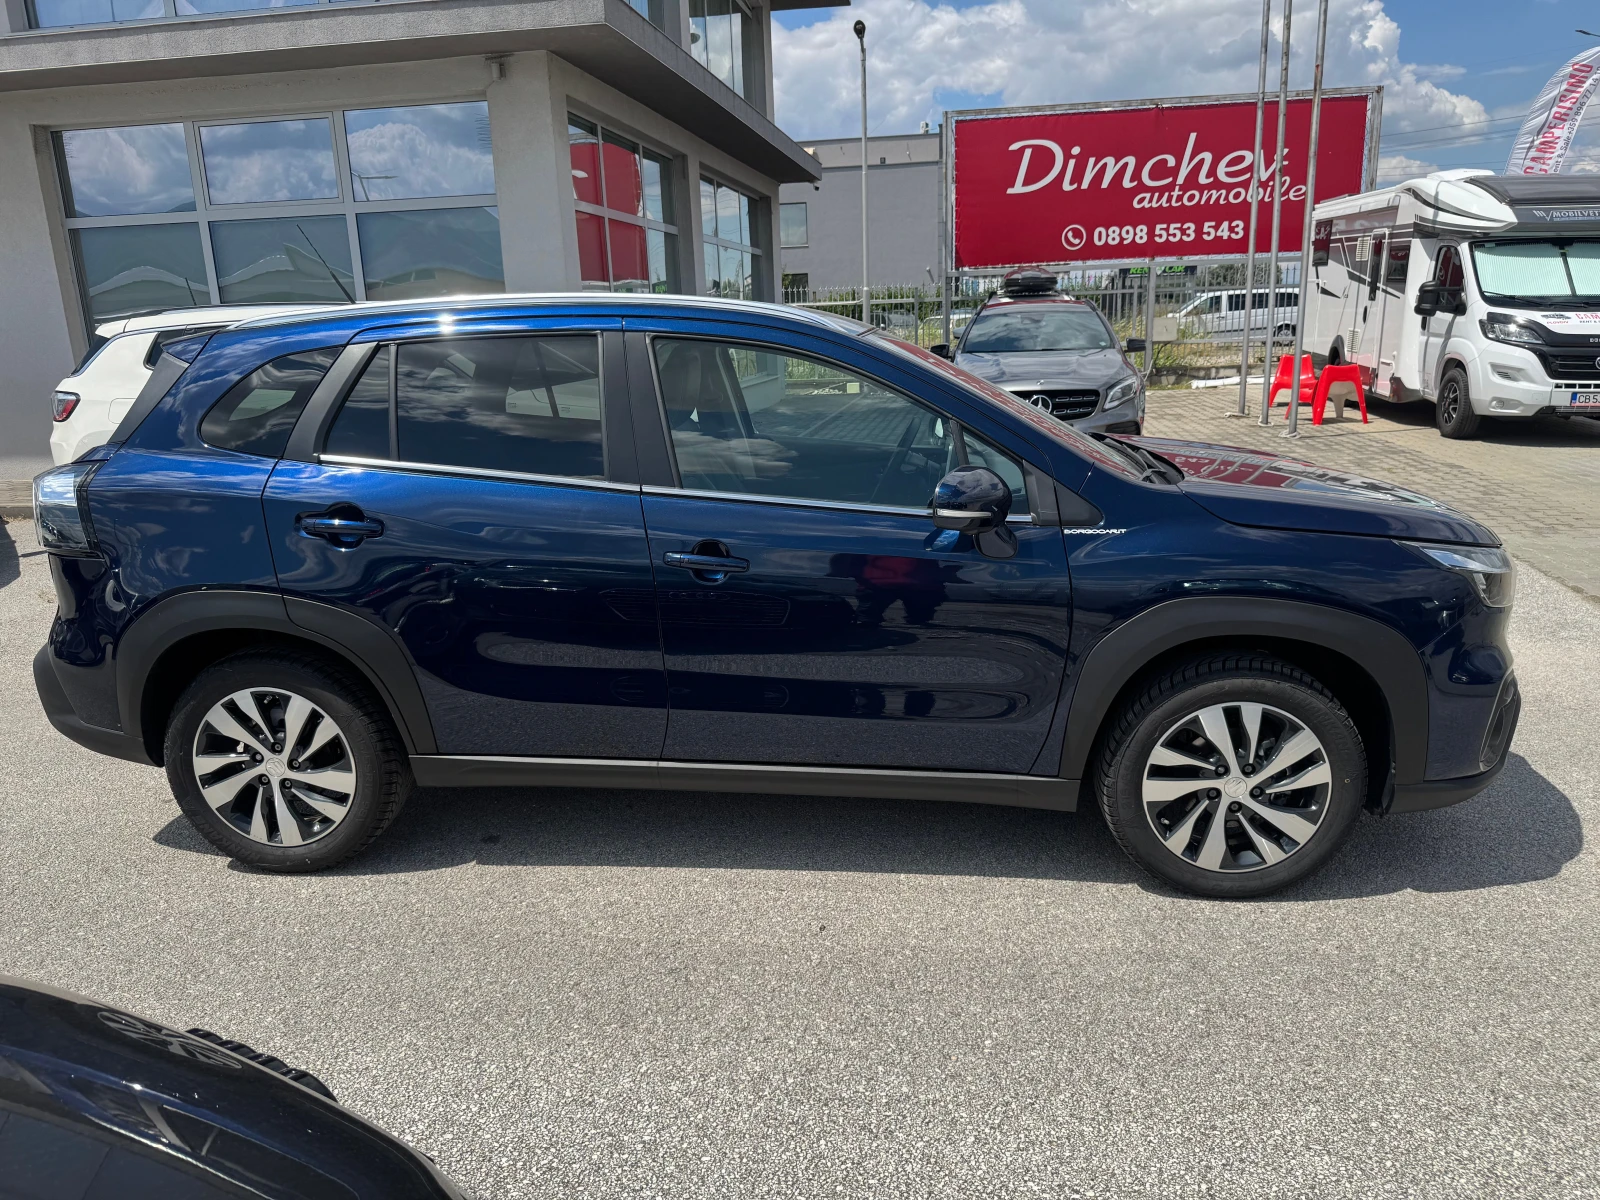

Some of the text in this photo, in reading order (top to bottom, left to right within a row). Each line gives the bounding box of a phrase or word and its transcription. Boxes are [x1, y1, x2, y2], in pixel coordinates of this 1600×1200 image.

[1006, 132, 1290, 195] Dimchev
[1132, 175, 1307, 209] automobile
[1093, 219, 1245, 246] 0898 553 543
[1578, 394, 1591, 404] CB
